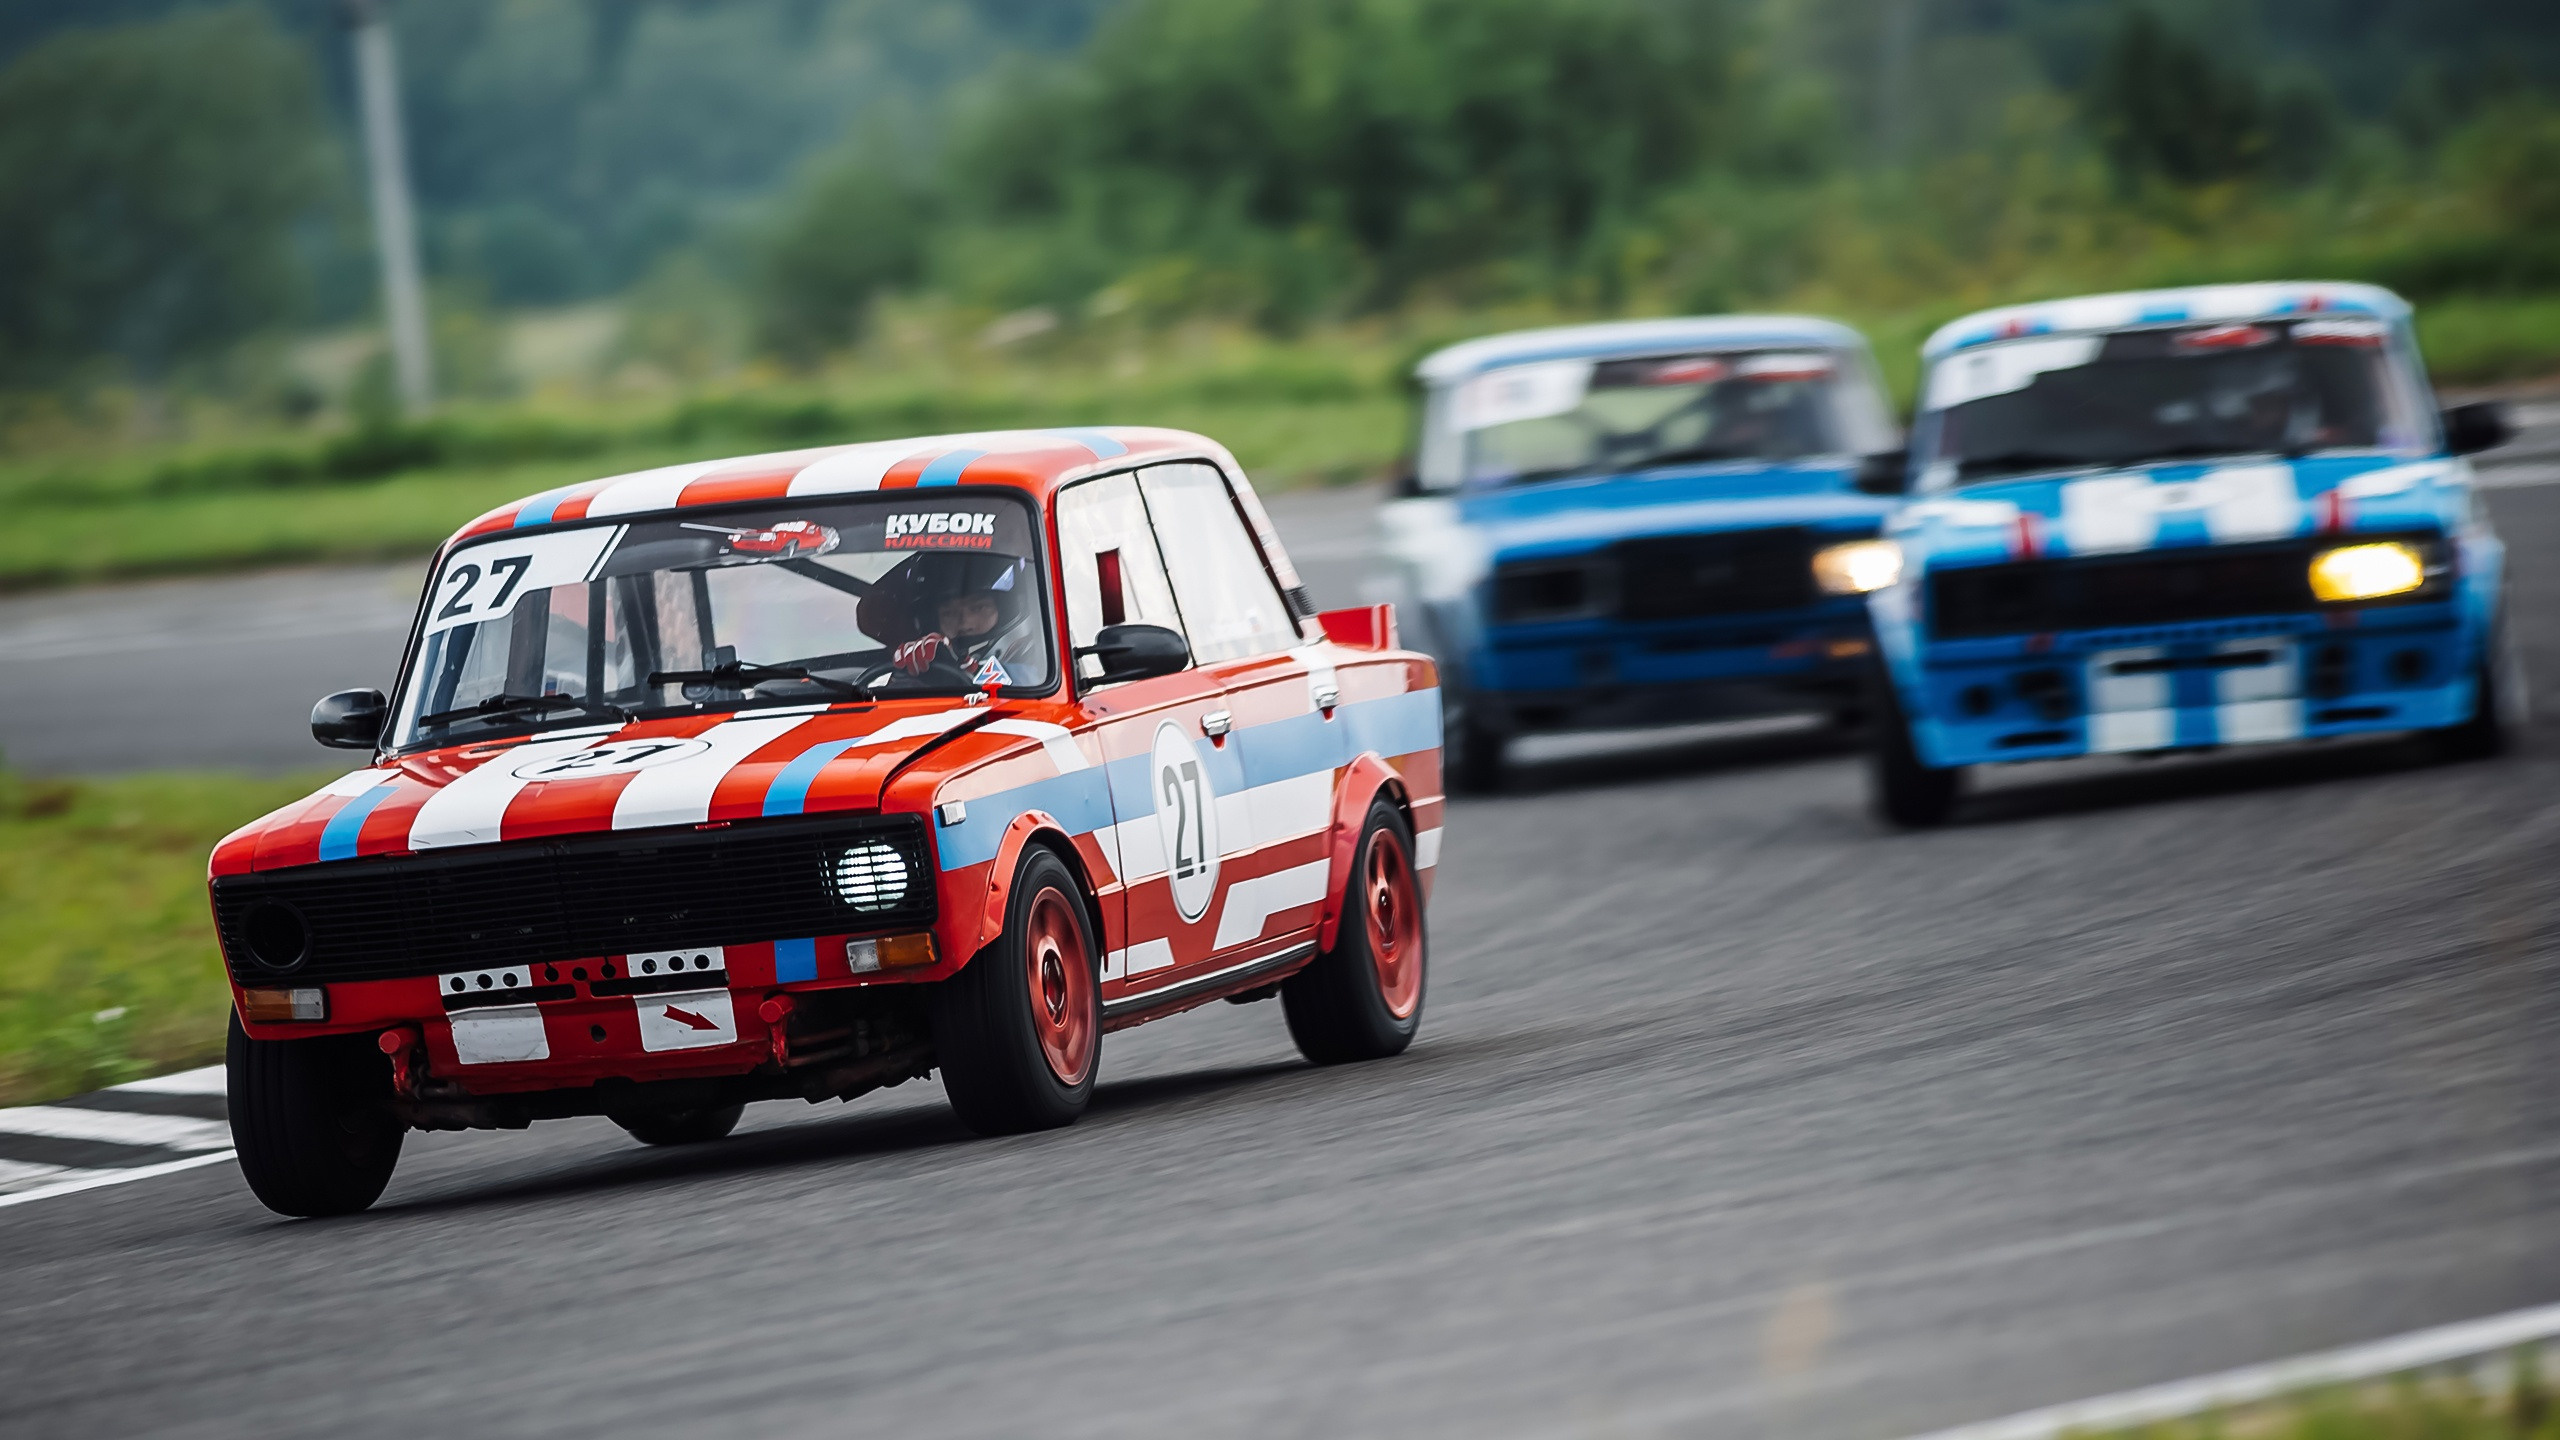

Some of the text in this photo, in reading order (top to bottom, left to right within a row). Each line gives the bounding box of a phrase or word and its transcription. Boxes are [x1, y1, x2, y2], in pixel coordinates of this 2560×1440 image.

[885, 512, 996, 535] КУБОК
[884, 534, 994, 549] КЛАССИКИ
[437, 554, 533, 622] 27
[536, 743, 686, 775] 27
[1162, 759, 1206, 880] 27
